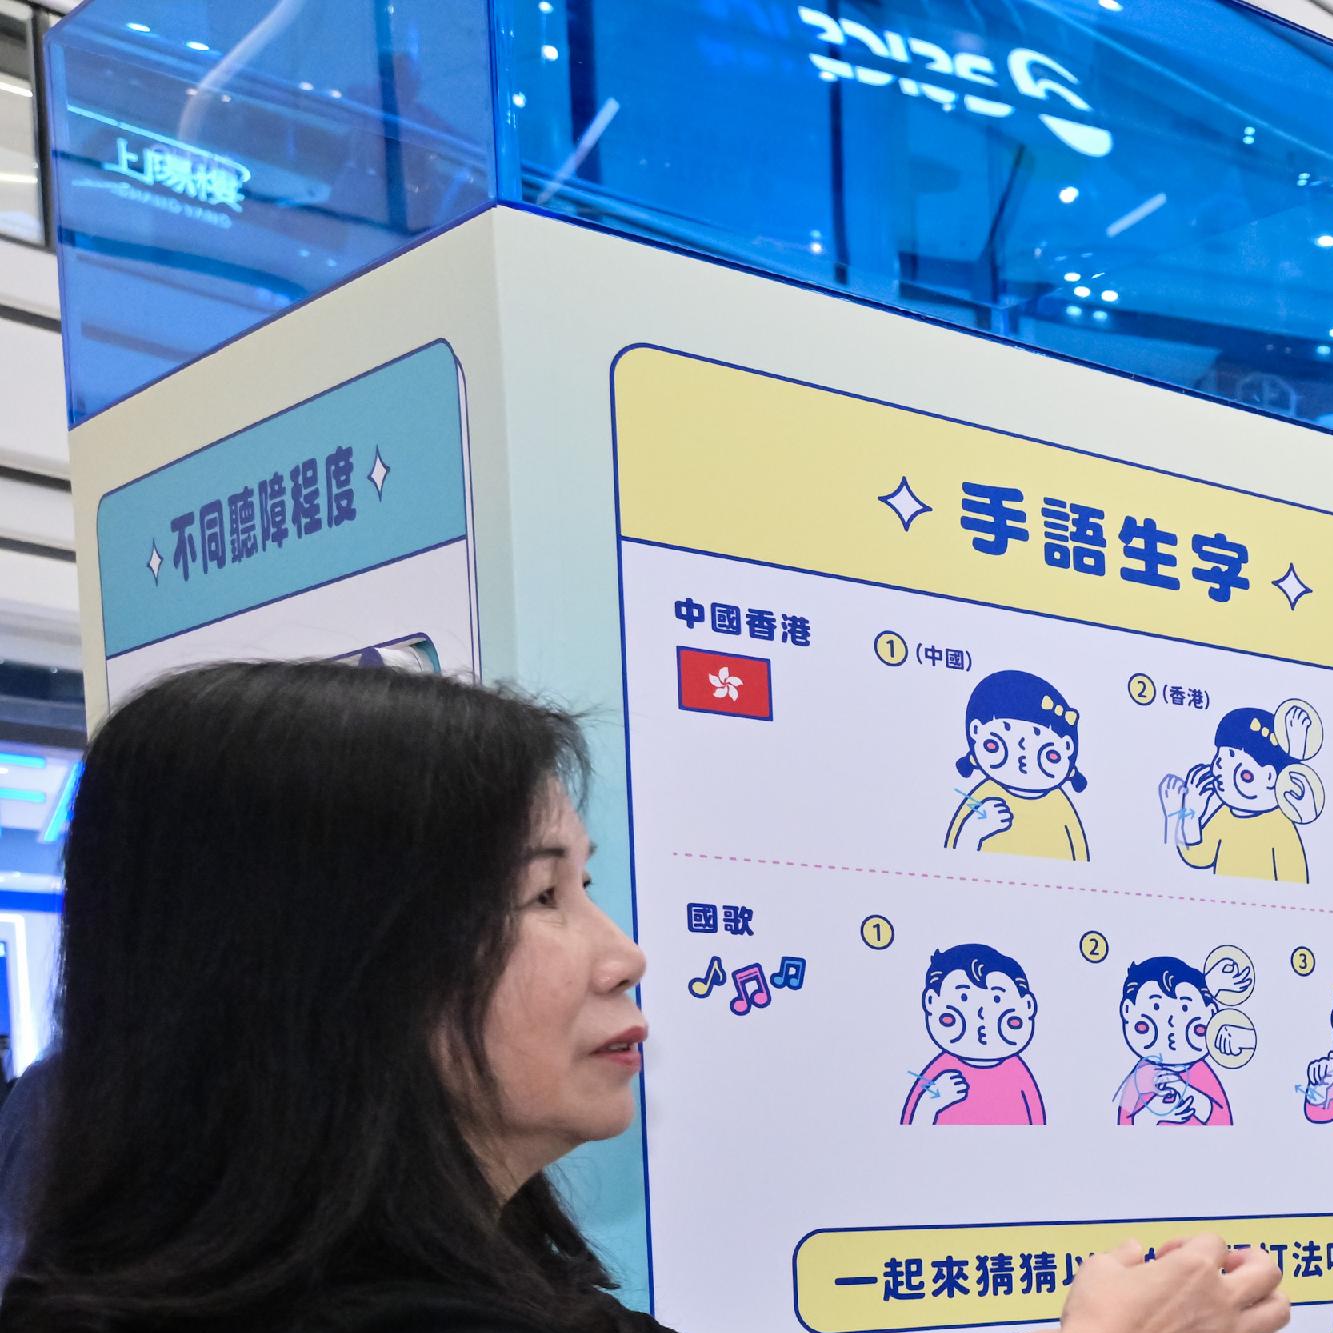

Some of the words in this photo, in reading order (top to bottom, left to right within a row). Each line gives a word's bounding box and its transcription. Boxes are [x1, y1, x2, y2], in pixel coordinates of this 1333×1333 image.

[170, 445, 357, 582] 不同聽障程度
[960, 481, 1252, 604] 手語生字
[674, 598, 811, 648] 中國香港
[916, 643, 972, 672] (中國)
[1163, 685, 1211, 710] (香港)
[686, 903, 755, 937] 國歌
